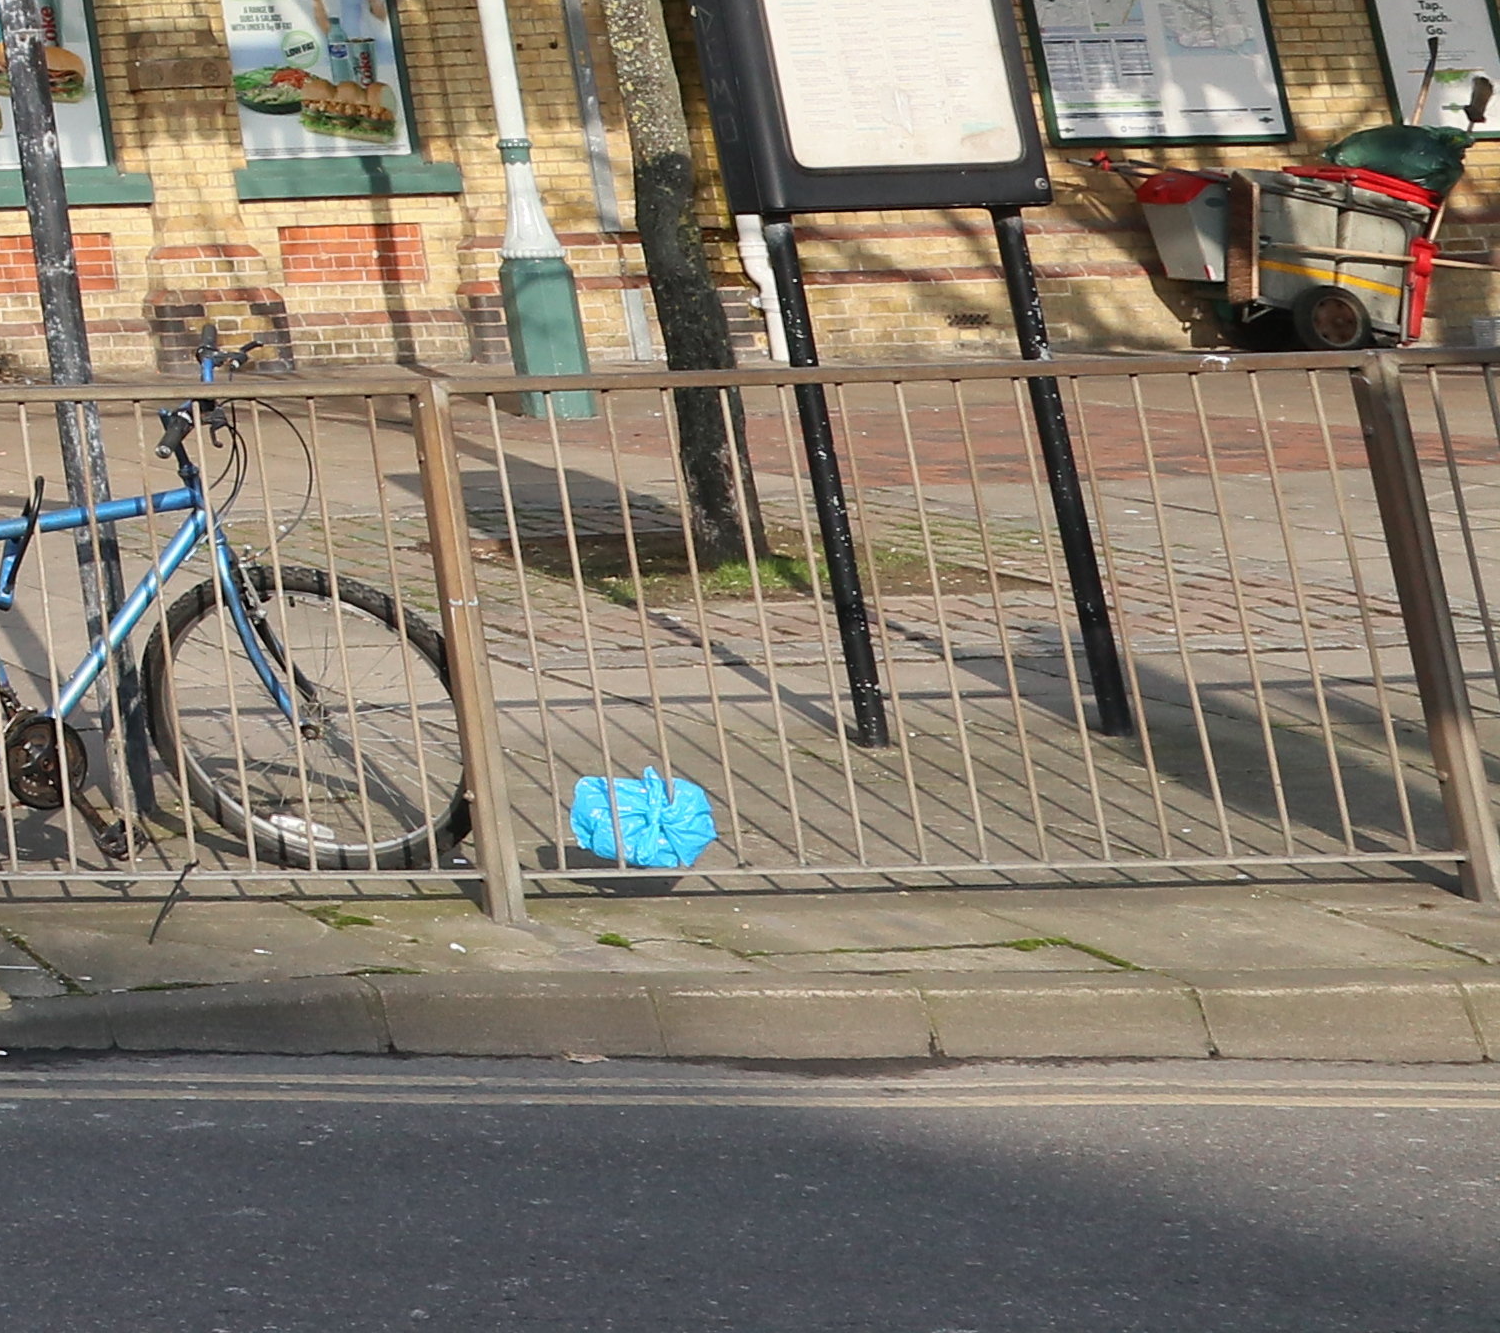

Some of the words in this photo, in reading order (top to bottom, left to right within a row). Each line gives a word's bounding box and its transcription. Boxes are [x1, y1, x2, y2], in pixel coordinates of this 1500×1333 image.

[1417, 0, 1443, 11] Tap.
[40, 5, 57, 41] oke
[1413, 13, 1452, 23] Touch.
[1426, 25, 1447, 35] Go.
